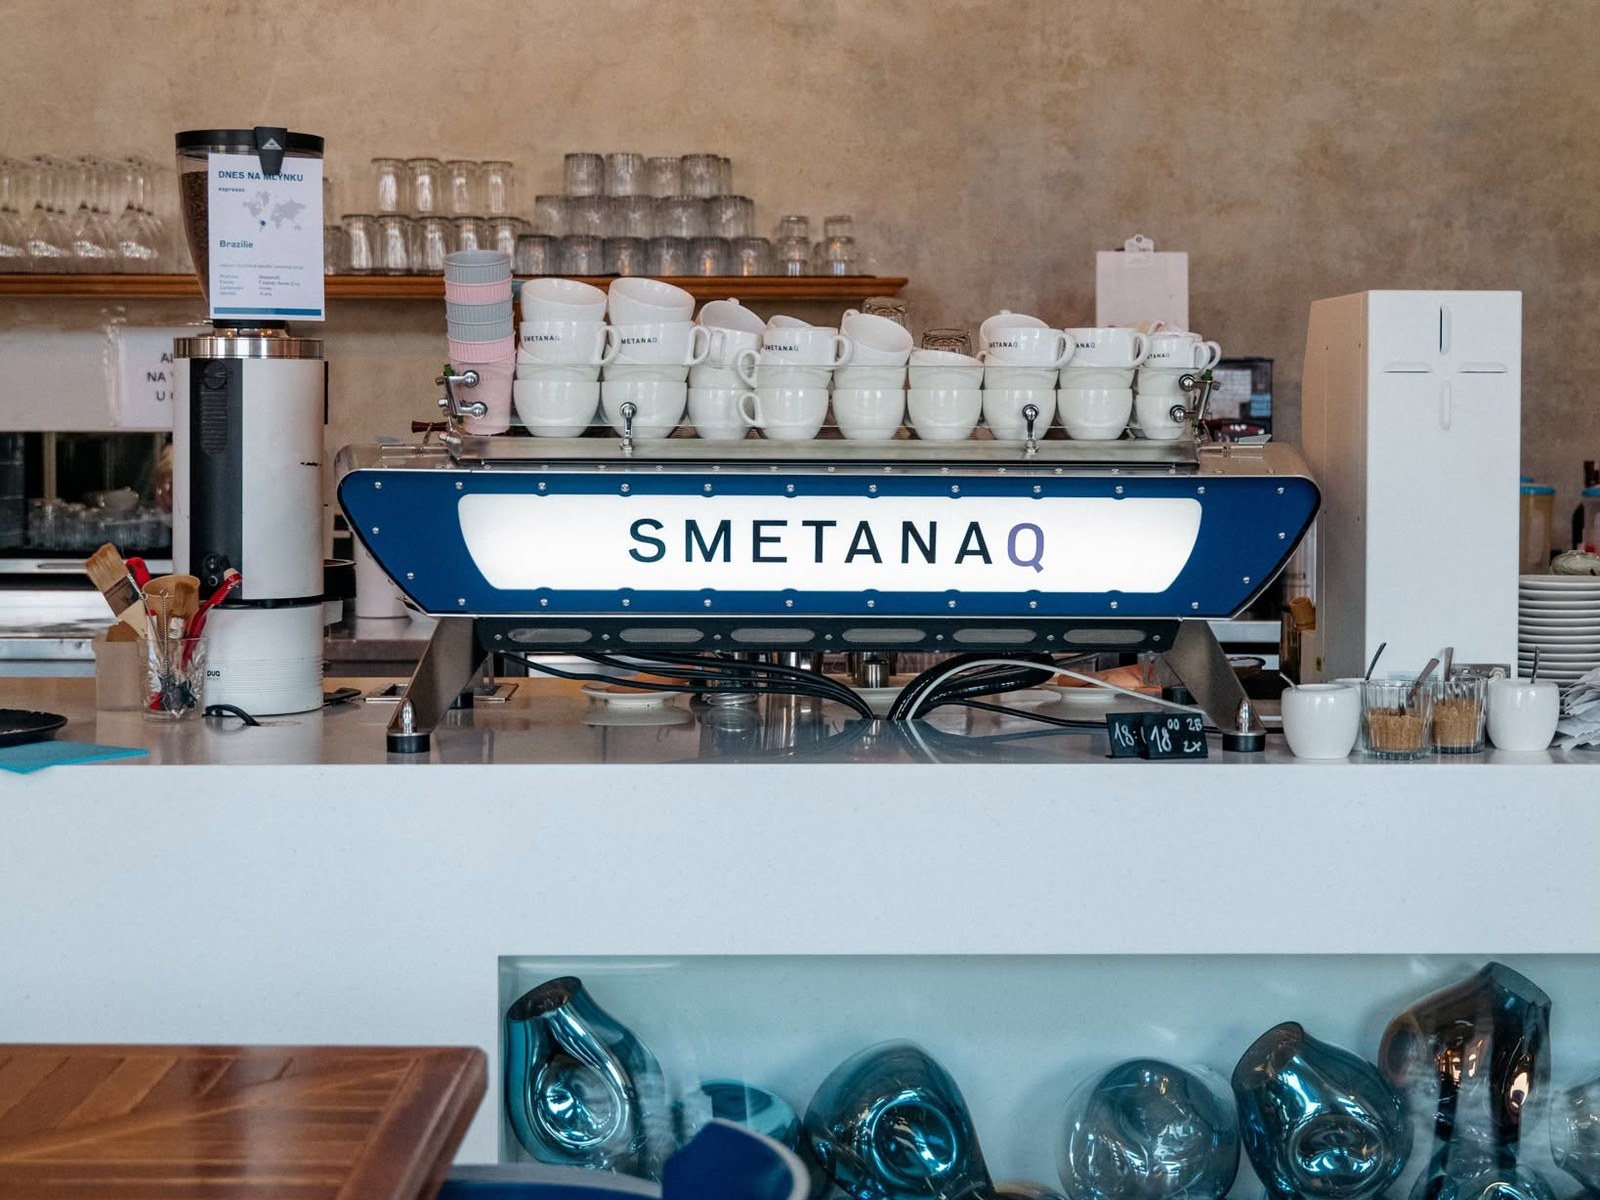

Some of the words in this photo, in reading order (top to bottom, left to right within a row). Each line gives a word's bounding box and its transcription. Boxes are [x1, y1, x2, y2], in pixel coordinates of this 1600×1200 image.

[218, 170, 245, 179] DNES
[247, 172, 261, 180] NA
[621, 337, 657, 345] METANAQ
[147, 371, 166, 382] NA
[156, 391, 166, 401] U
[628, 518, 1046, 573] SMETANAQ
